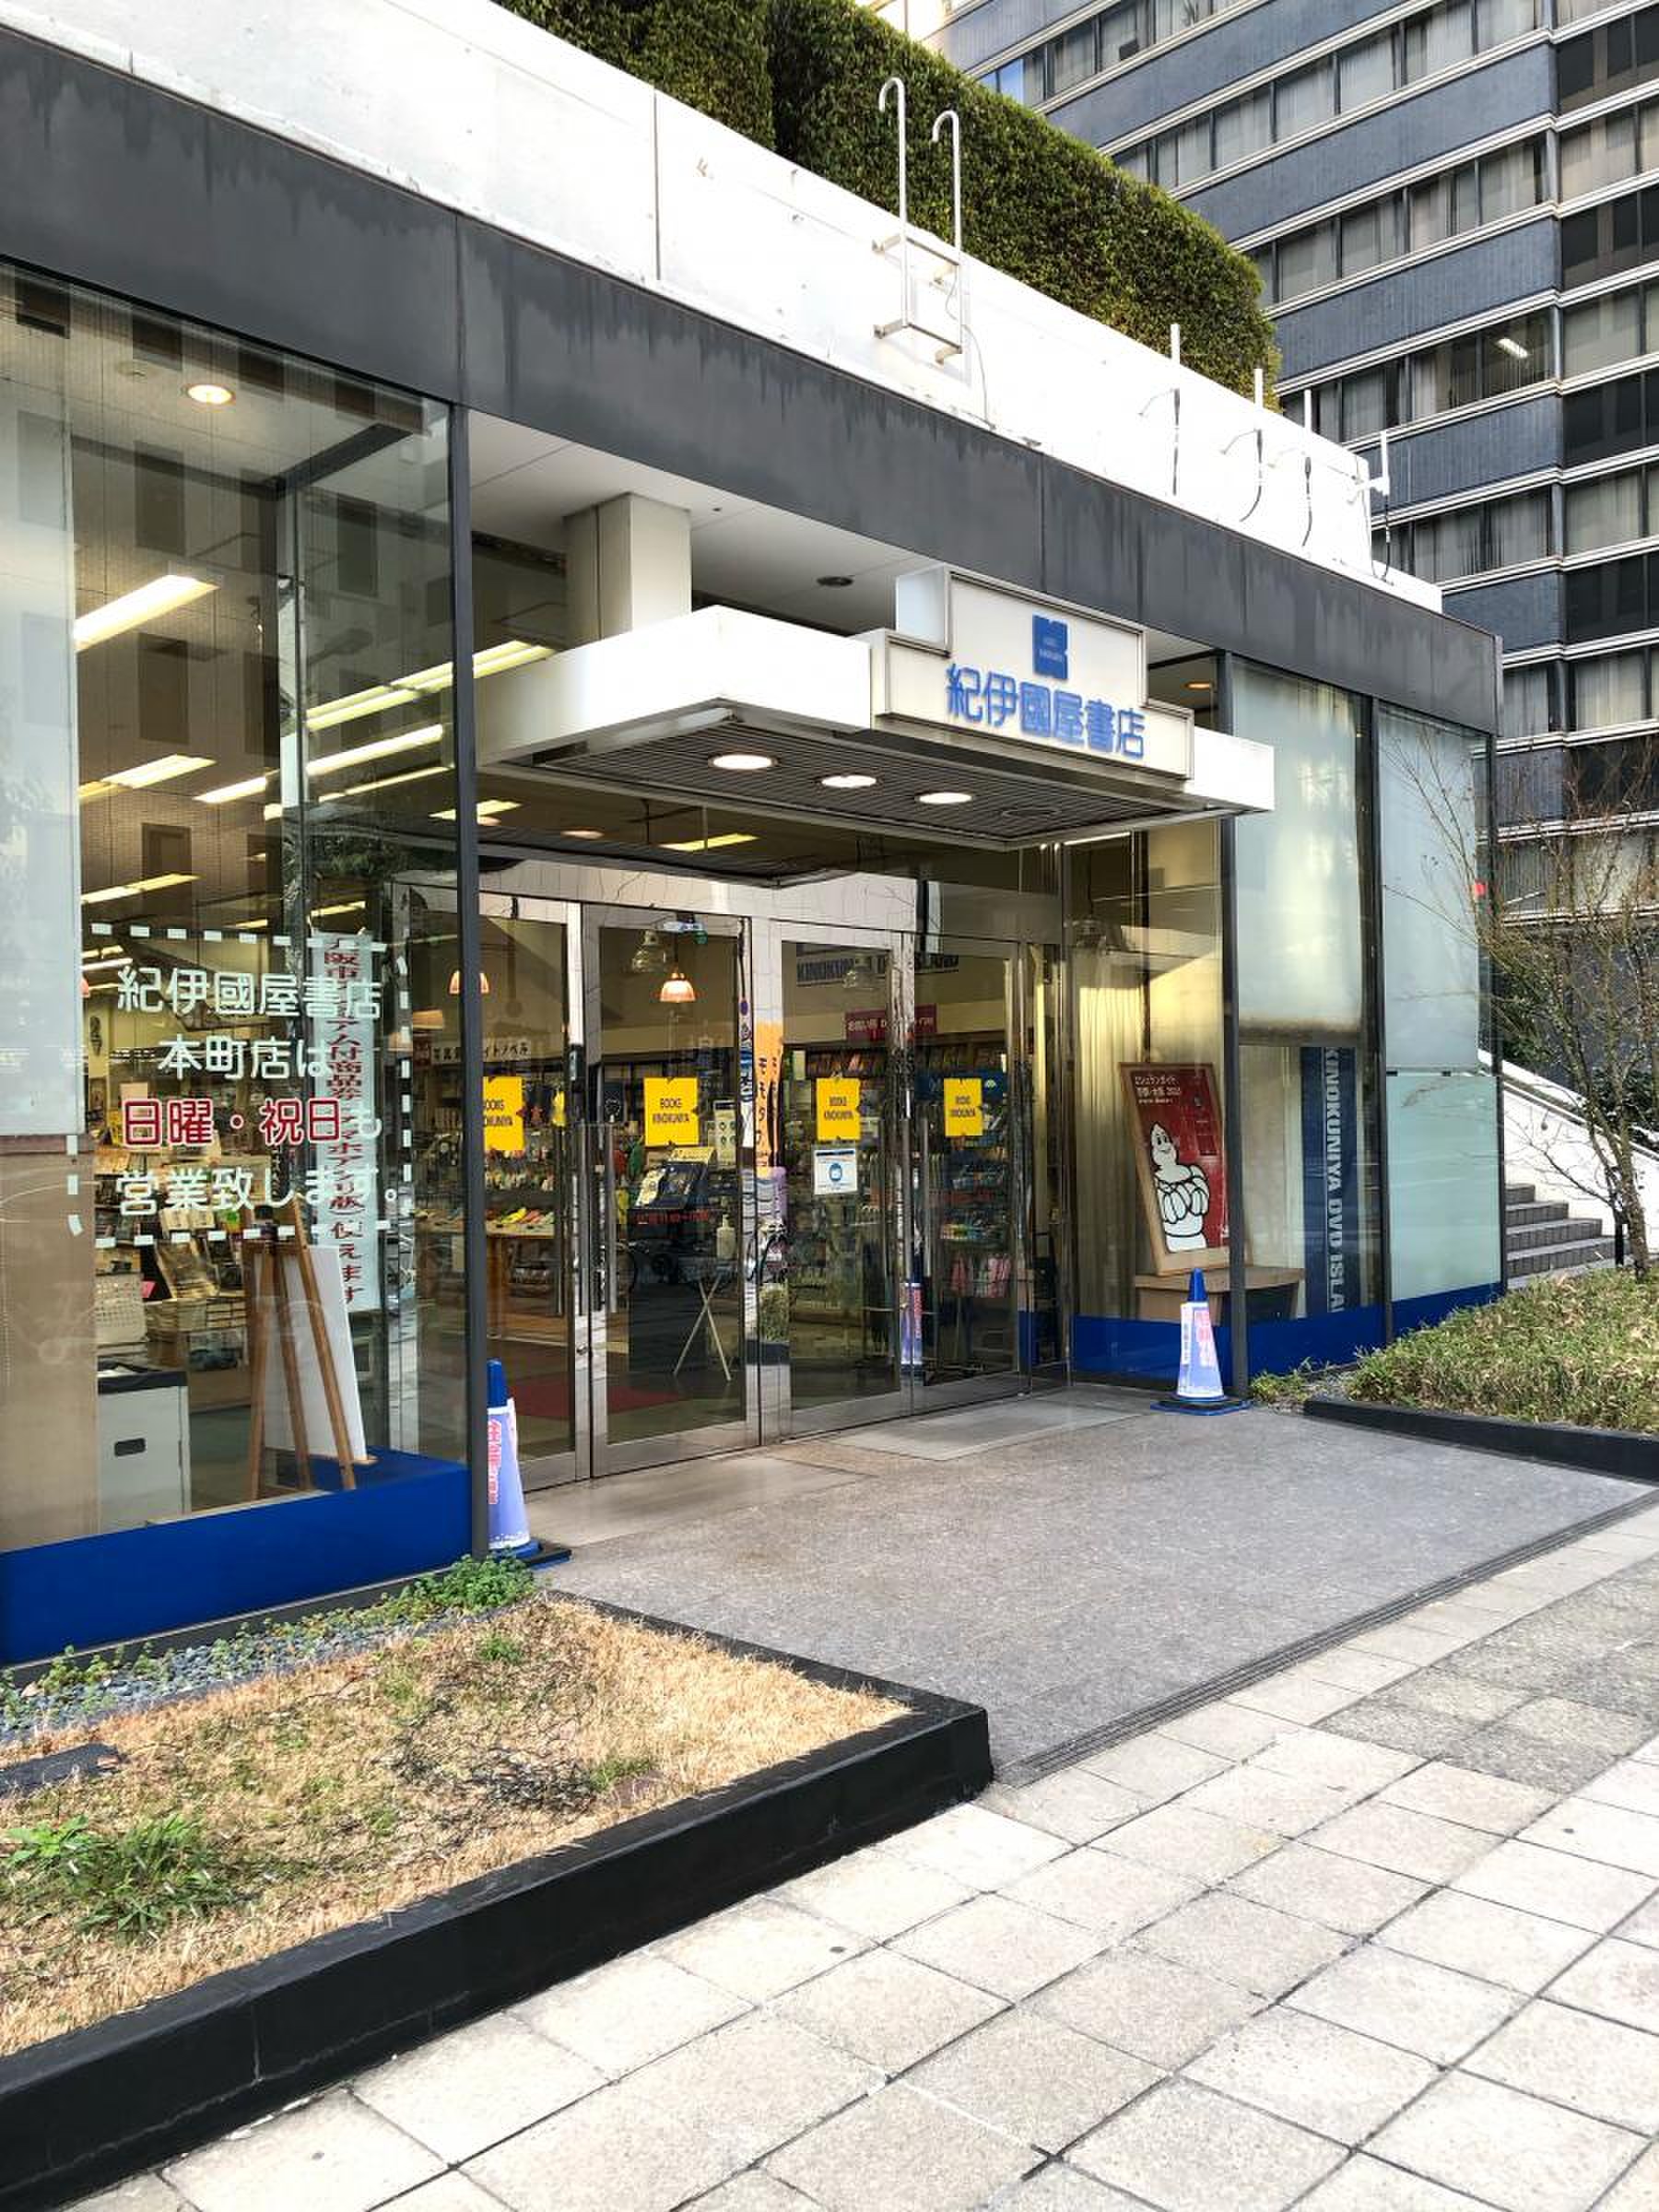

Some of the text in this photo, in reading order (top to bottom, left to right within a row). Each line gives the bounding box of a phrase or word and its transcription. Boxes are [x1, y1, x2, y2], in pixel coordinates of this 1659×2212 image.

[945, 663, 1145, 759] 紀伊國屋書店
[117, 965, 382, 1019] 紀伊國屋書店
[158, 1033, 331, 1080] 本町店は
[121, 1097, 382, 1149] 日曜・祝日も
[115, 1165, 398, 1217] 営業致します。
[1328, 1199, 1343, 1247] DVD
